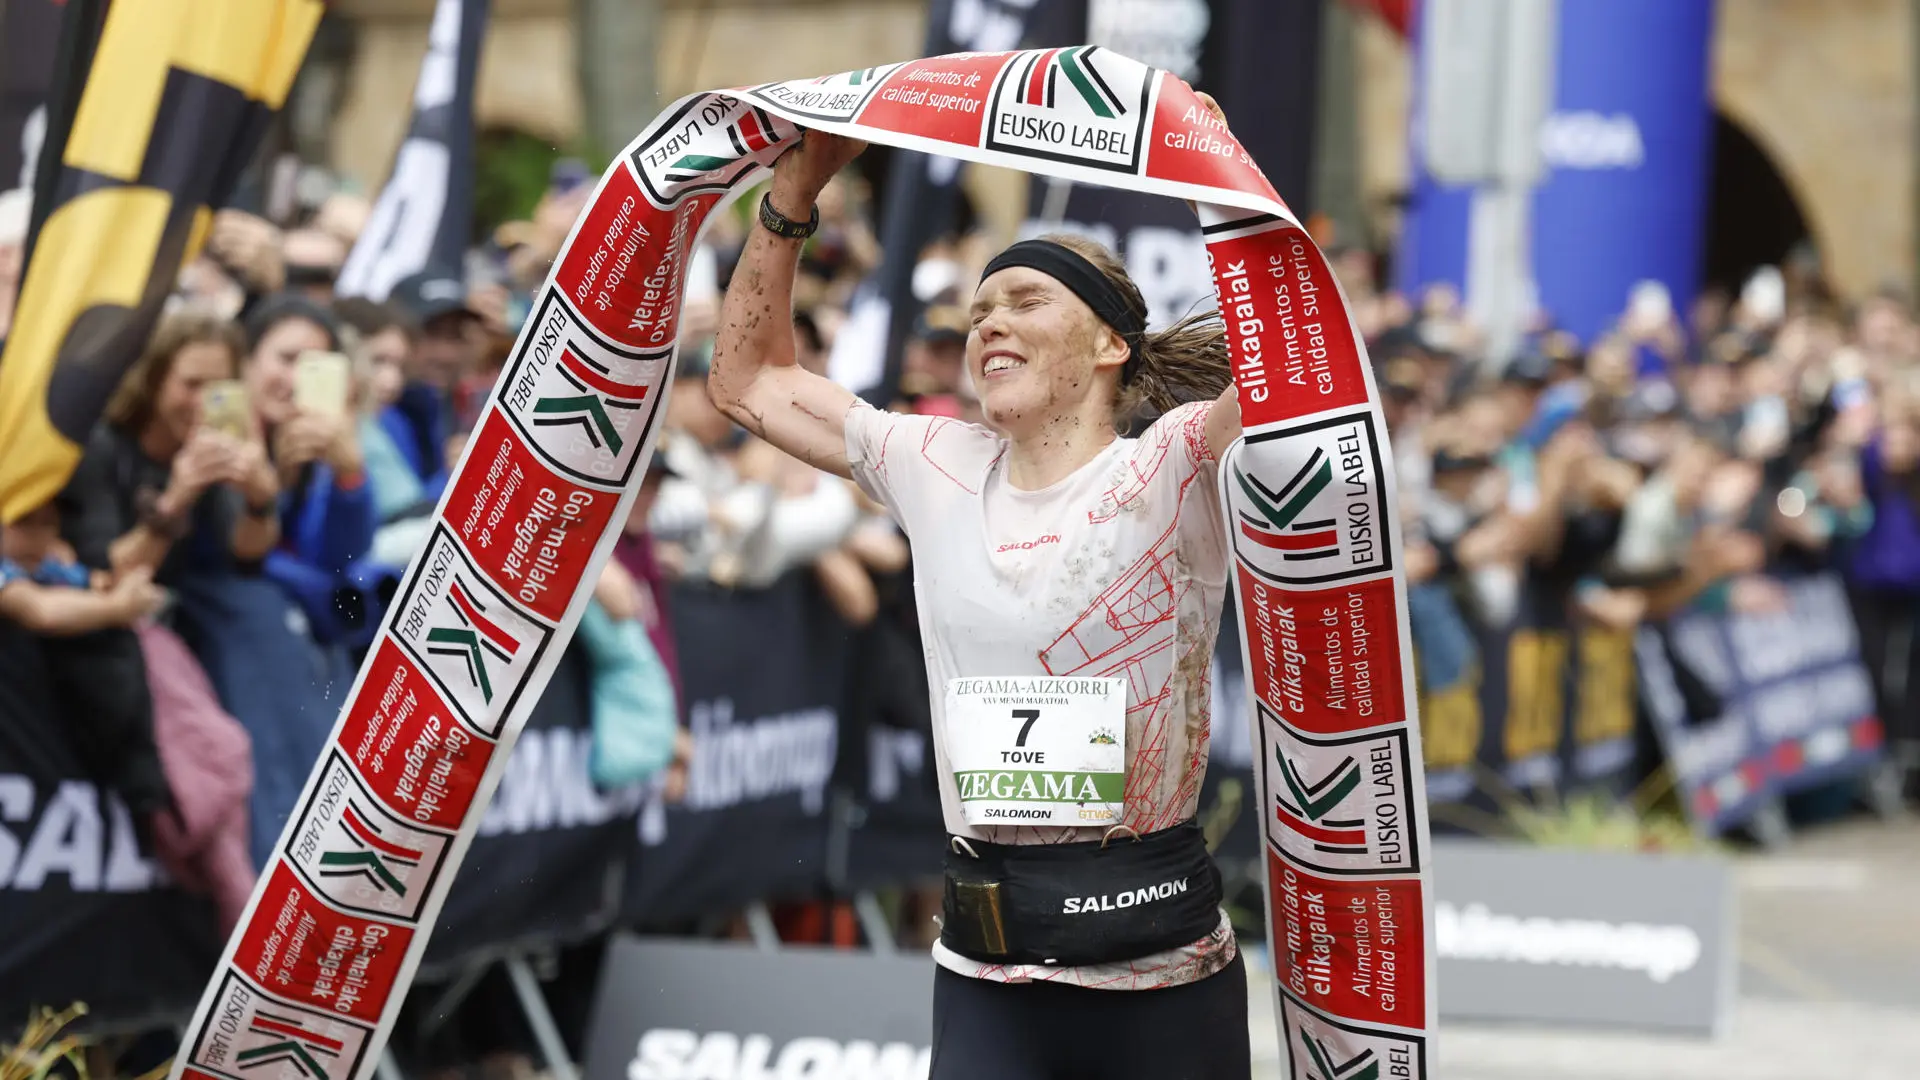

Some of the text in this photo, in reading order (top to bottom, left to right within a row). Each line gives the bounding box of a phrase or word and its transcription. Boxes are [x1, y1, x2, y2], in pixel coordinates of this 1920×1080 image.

[769, 86, 861, 111] EUSKO LABEL
[881, 87, 981, 113] calidad superior
[903, 68, 981, 88] Alimentos de
[644, 94, 739, 168] SKO LABEL
[999, 113, 1130, 155] EUSKO LABEL
[1163, 130, 1235, 158] calidad
[575, 195, 636, 305] calidad superior
[594, 221, 651, 311] Alimentos de
[509, 307, 567, 412] EUSKO LABEL
[1222, 259, 1269, 403] elikagaiak
[1268, 254, 1307, 386] Alimentos de
[1288, 235, 1334, 395] calidad superior
[462, 438, 513, 540] calidad superior
[477, 462, 525, 548] Alimentos de
[501, 487, 558, 580] elikagaiak
[1337, 426, 1374, 565] EUSKO LABEL
[402, 542, 455, 641] EUSKO LABEL
[519, 490, 594, 603] Goi-mailako
[957, 680, 1110, 695] ZEGAMA-AIZKORRI
[1252, 583, 1283, 711] Goi-mailako
[1272, 604, 1307, 713] elikagaiak
[1319, 607, 1347, 710] Alimentos de
[1344, 592, 1373, 717] calidad superior
[356, 665, 408, 766] calidad superior
[370, 688, 418, 774] Alimentos de
[999, 697, 1024, 705] MENDI
[1012, 709, 1040, 747] 7
[394, 715, 442, 803] elikagaiak
[414, 726, 470, 822] Goi-mailako
[959, 772, 1102, 800] ZEGAMA
[1001, 751, 1045, 764] TOVE
[1370, 739, 1402, 865] EUSKO LABEL
[296, 767, 349, 869] EUSKO LABEL
[984, 808, 1052, 819] SALOMON
[255, 887, 301, 983] calidad superior
[1063, 877, 1189, 914] SALOMON
[1280, 868, 1308, 996] Goi-mailako
[276, 909, 317, 986] Alimentos de
[311, 925, 357, 999] elikagaiak
[335, 924, 389, 1013] Goi-mailako
[1302, 890, 1336, 996] elikagaiak
[1347, 897, 1372, 997] Alimentos de
[1372, 887, 1399, 1012] calidad superior
[202, 985, 250, 1067] EUSKO LABEL
[1389, 1044, 1410, 1080] BEL
